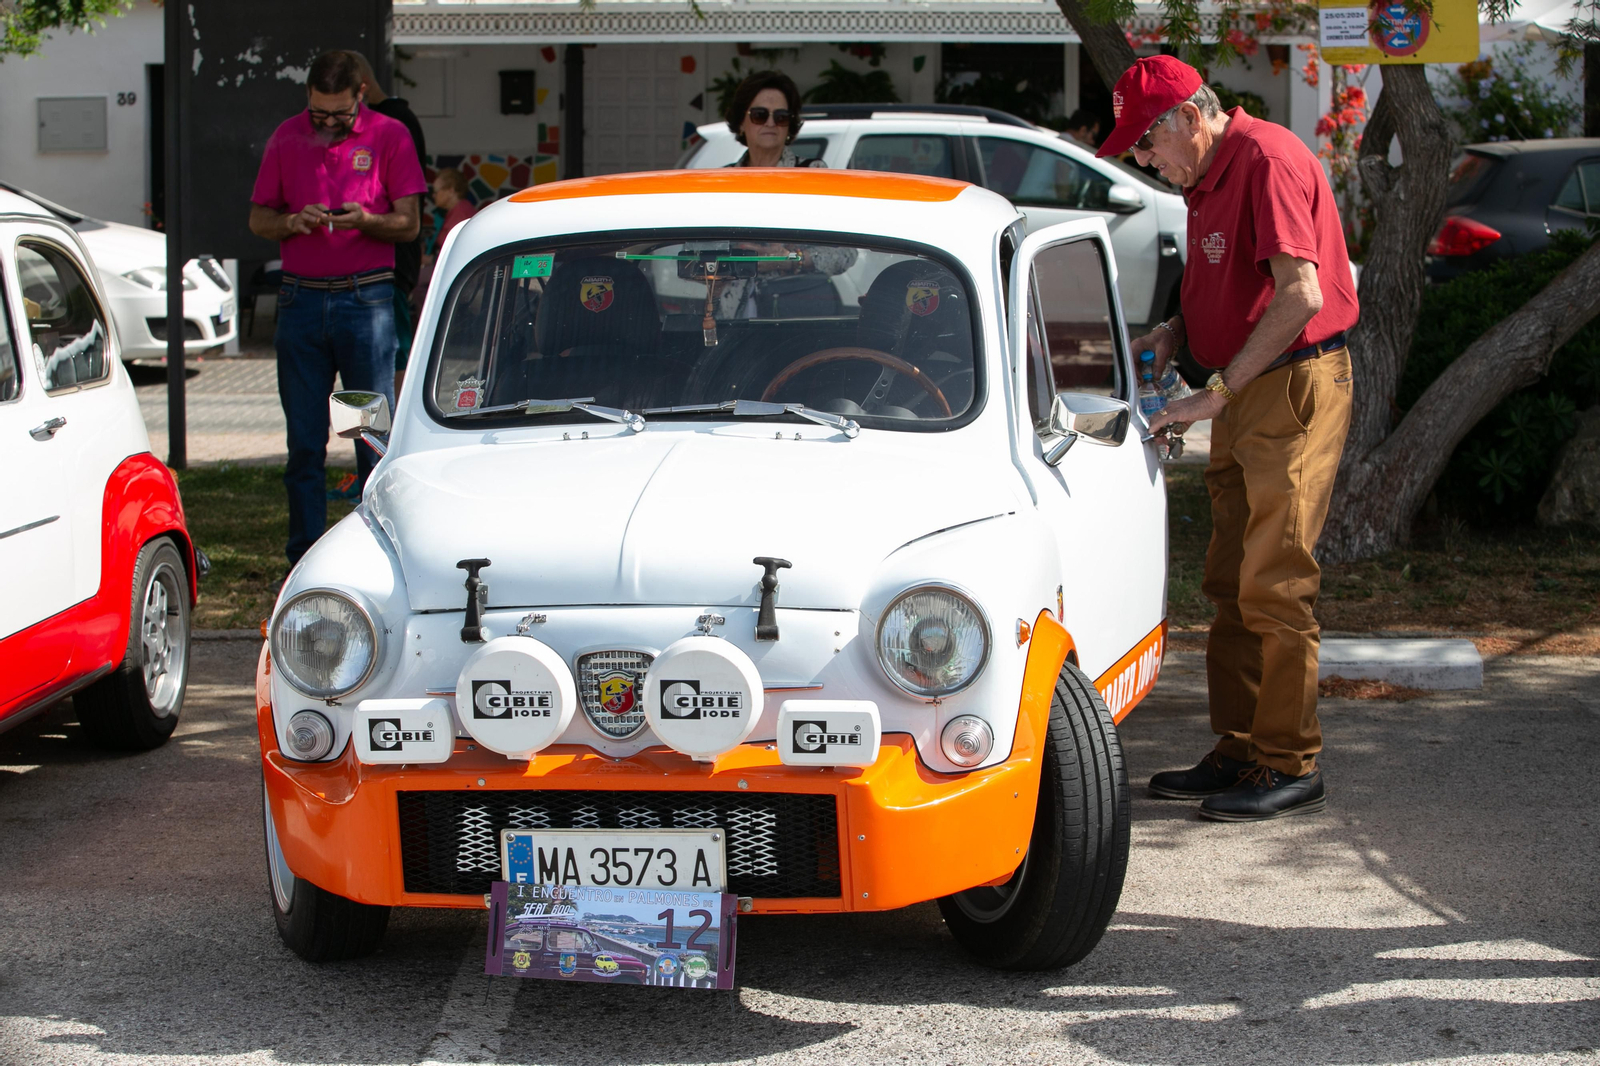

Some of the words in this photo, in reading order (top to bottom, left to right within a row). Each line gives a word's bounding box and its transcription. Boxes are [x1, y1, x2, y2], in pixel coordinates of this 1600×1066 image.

[116, 91, 137, 106] 39
[537, 260, 548, 268] 25
[515, 709, 551, 717] IODE
[702, 710, 741, 718] IODE
[538, 847, 581, 886] MA
[590, 847, 678, 886] 3573
[692, 848, 712, 887] A
[516, 885, 524, 898] I
[532, 886, 613, 903] ENCUENTRO
[627, 891, 700, 908] PALMONES
[523, 902, 548, 916] SEAT
[551, 904, 572, 915] 600
[656, 908, 713, 950] 12
